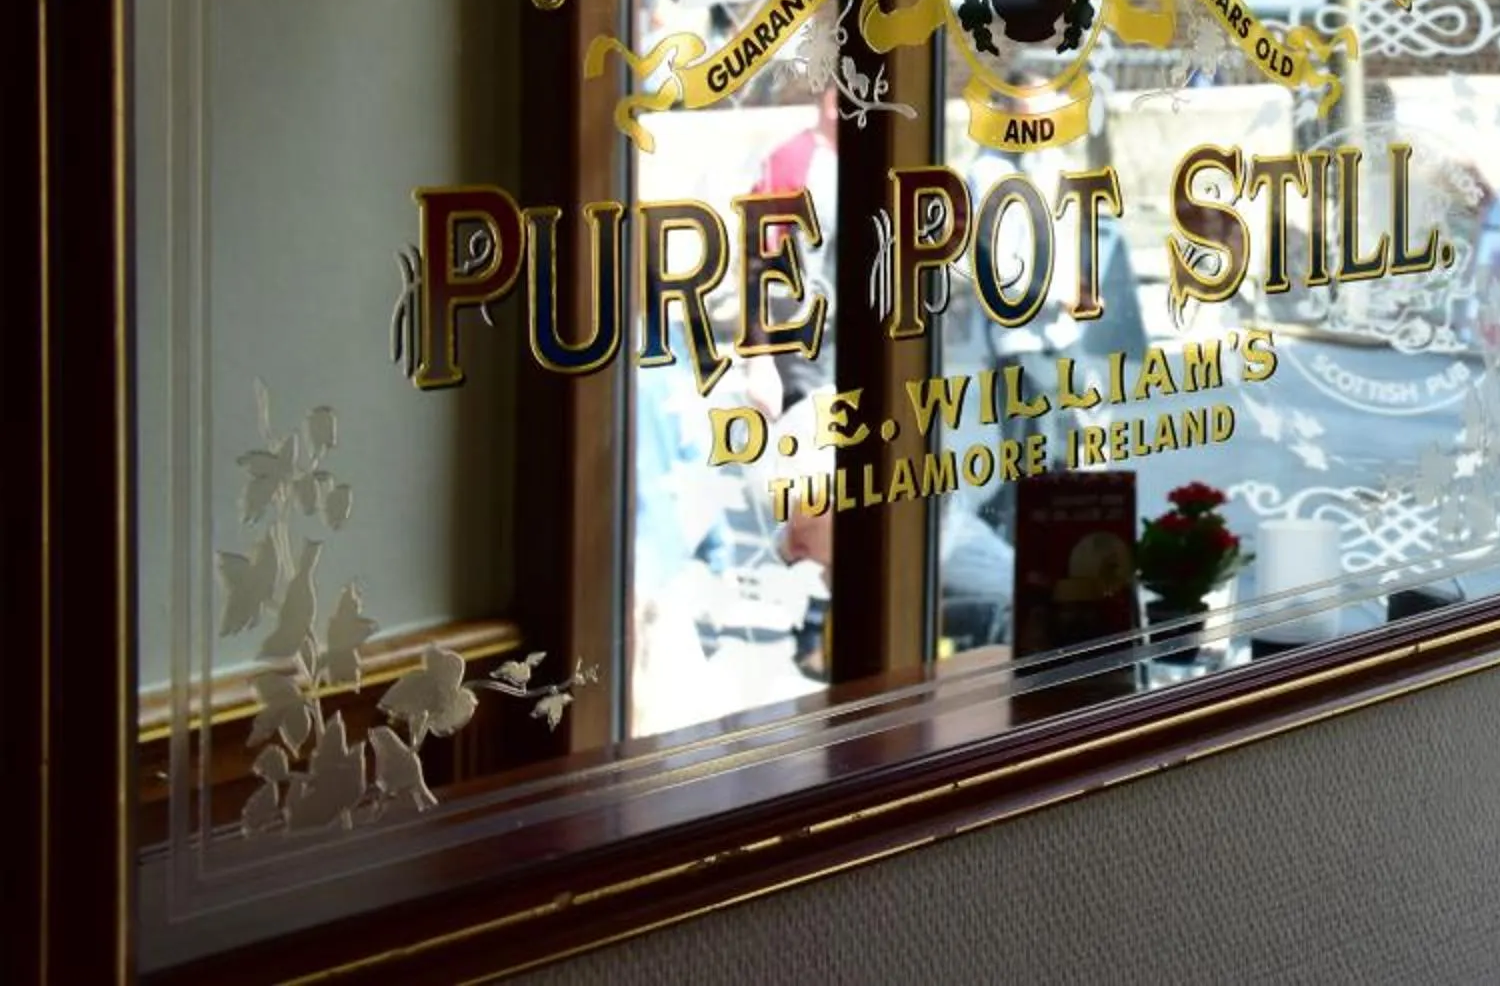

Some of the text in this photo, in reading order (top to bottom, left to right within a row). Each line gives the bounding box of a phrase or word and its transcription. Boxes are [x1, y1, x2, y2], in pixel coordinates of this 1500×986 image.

[1255, 37, 1294, 78] OLD
[1003, 117, 1056, 145] AND
[413, 142, 1456, 398] PURE POT STILL.
[1425, 361, 1471, 397] PUB
[767, 403, 1237, 522] TULLAMORE IRELAND
